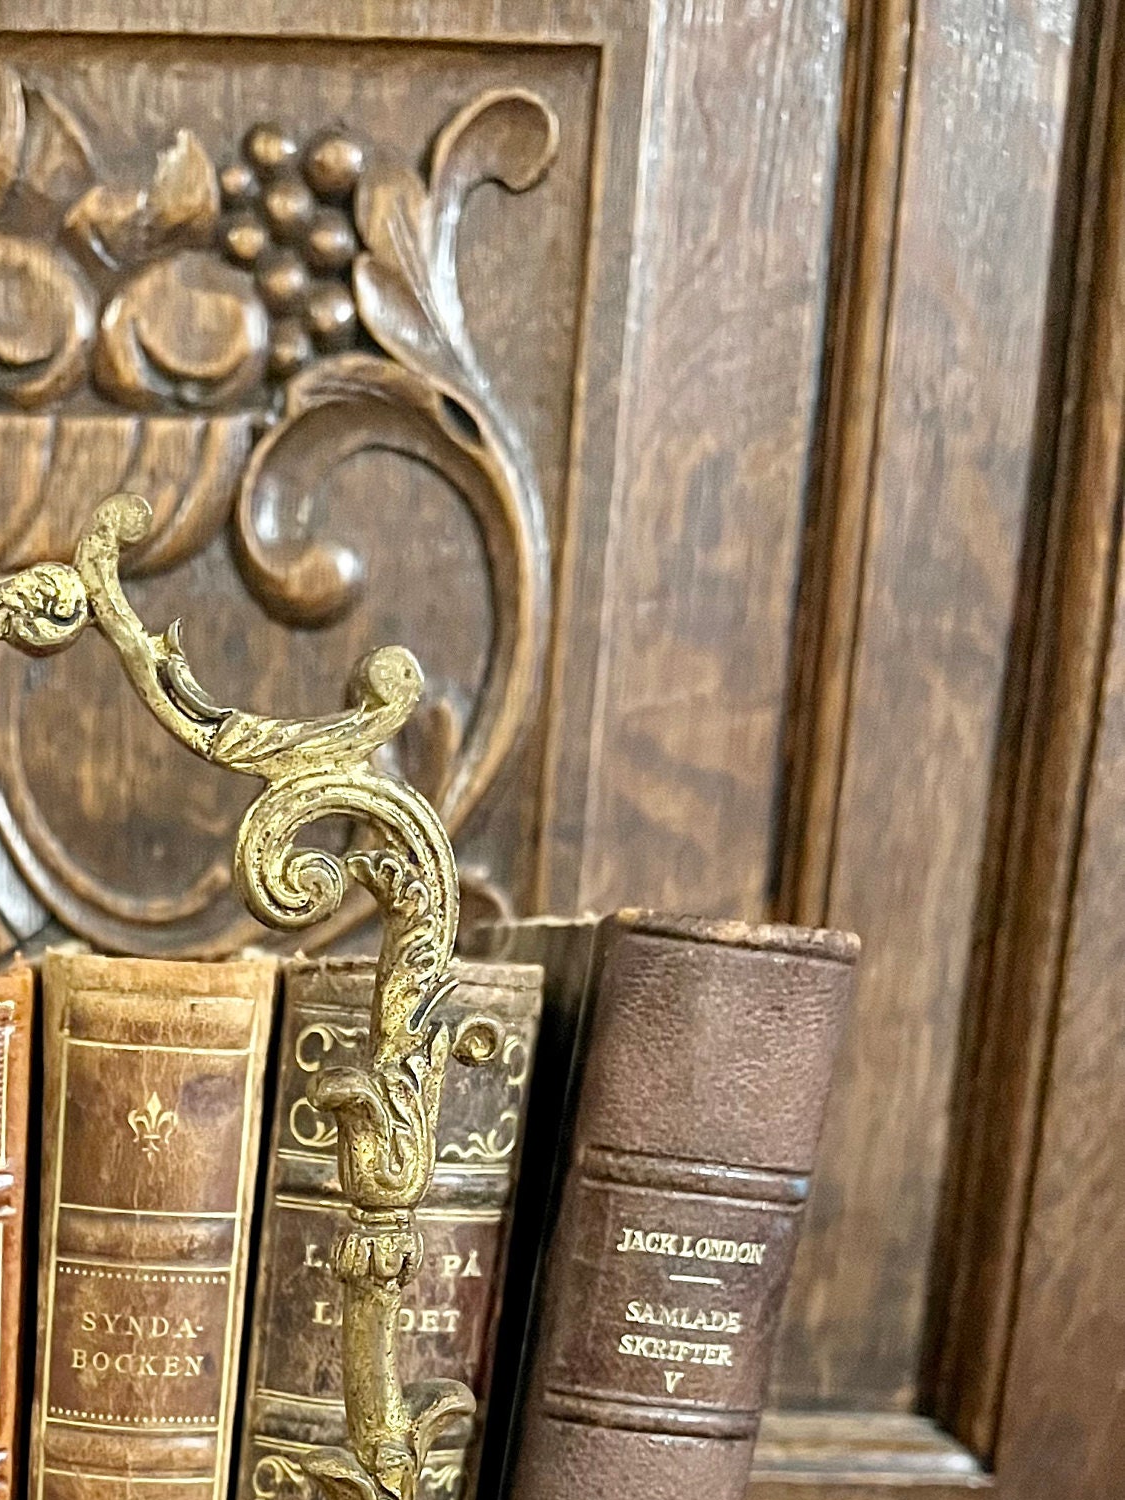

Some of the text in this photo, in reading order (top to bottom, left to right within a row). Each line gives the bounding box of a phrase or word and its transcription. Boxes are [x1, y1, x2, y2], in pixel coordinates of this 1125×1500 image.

[617, 1228, 767, 1265] JACK LONDON
[440, 1250, 483, 1278] PÅ
[80, 1311, 204, 1340] SYNDA-
[312, 1301, 461, 1333] LDET
[626, 1301, 742, 1335] SAMLADE
[71, 1348, 205, 1377] BOCKEN
[618, 1334, 733, 1367] SKRIFTER
[663, 1370, 685, 1394] V
